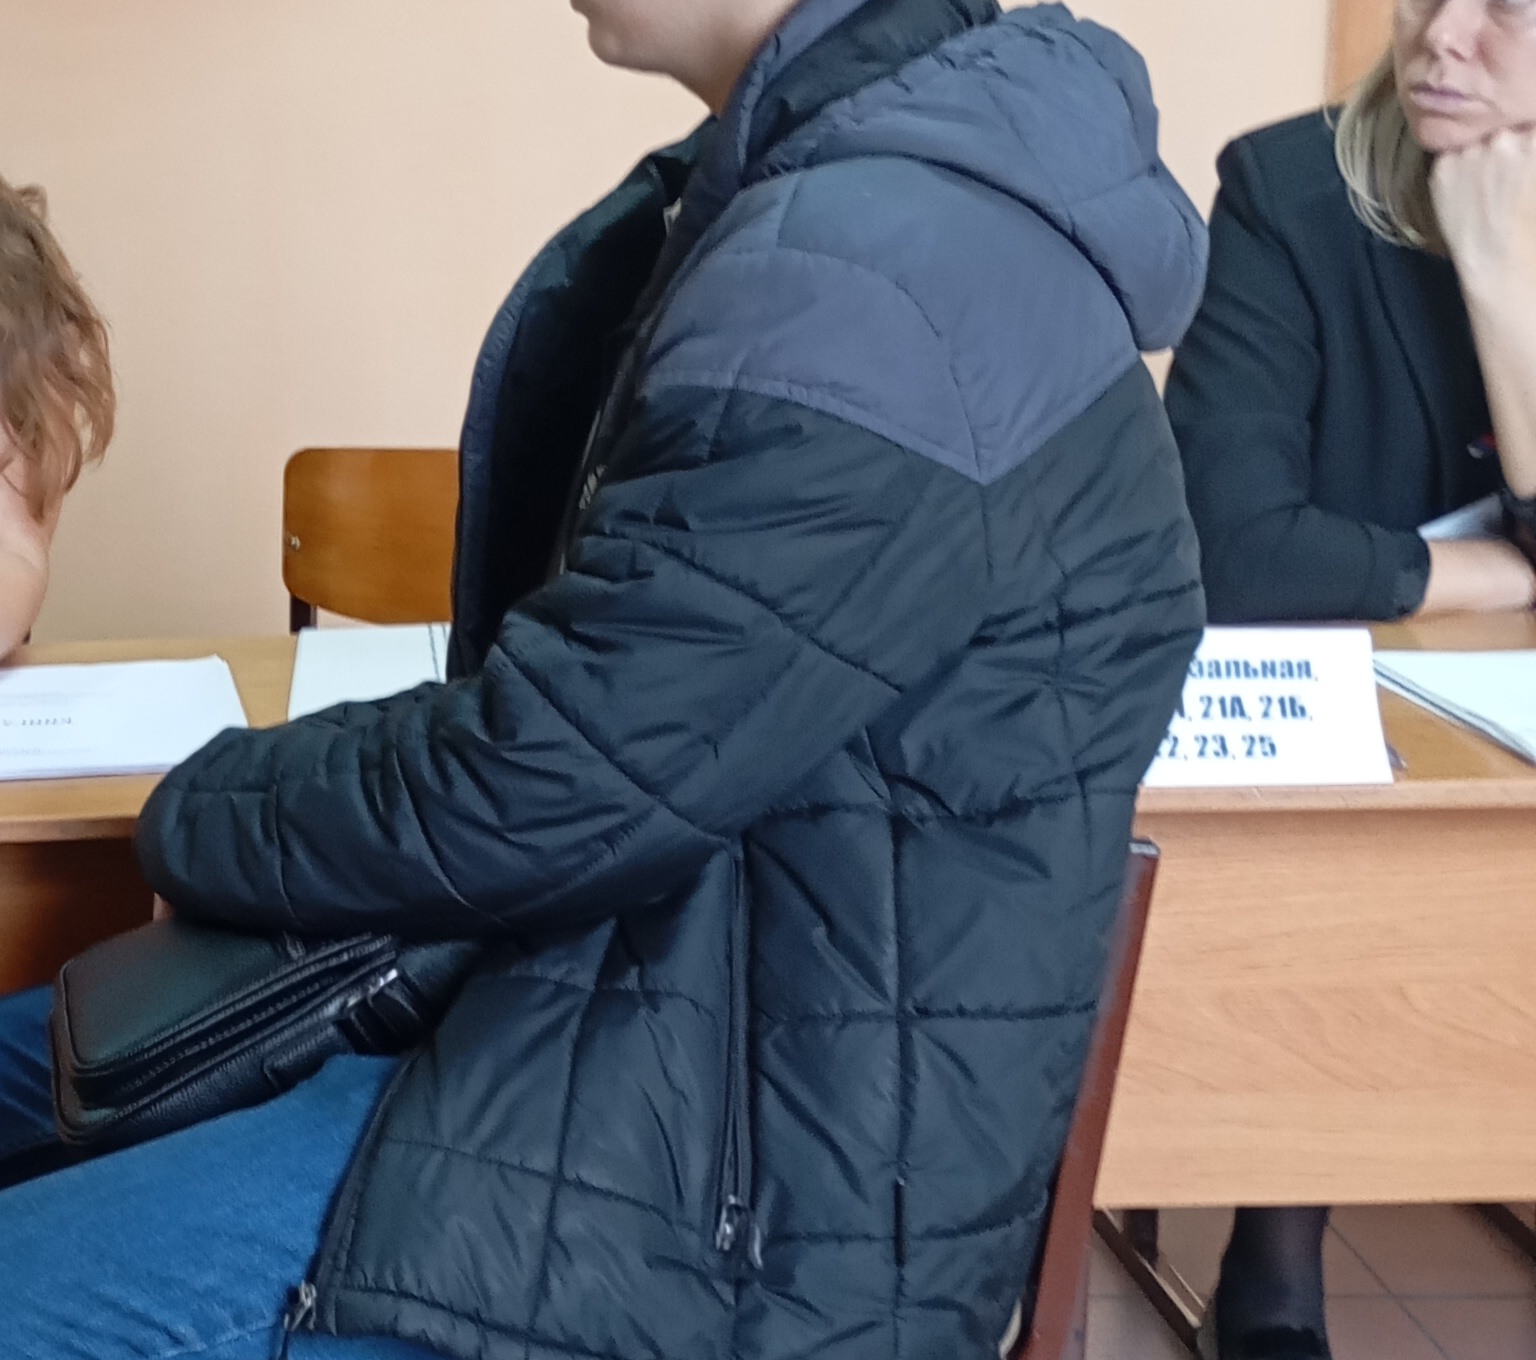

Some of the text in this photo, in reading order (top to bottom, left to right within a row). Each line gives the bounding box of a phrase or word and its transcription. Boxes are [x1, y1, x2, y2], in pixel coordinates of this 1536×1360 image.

[1199, 694, 1252, 721] 21А,
[1258, 694, 1313, 721] 21Б,
[1155, 733, 1277, 761] 2, 23, 25
